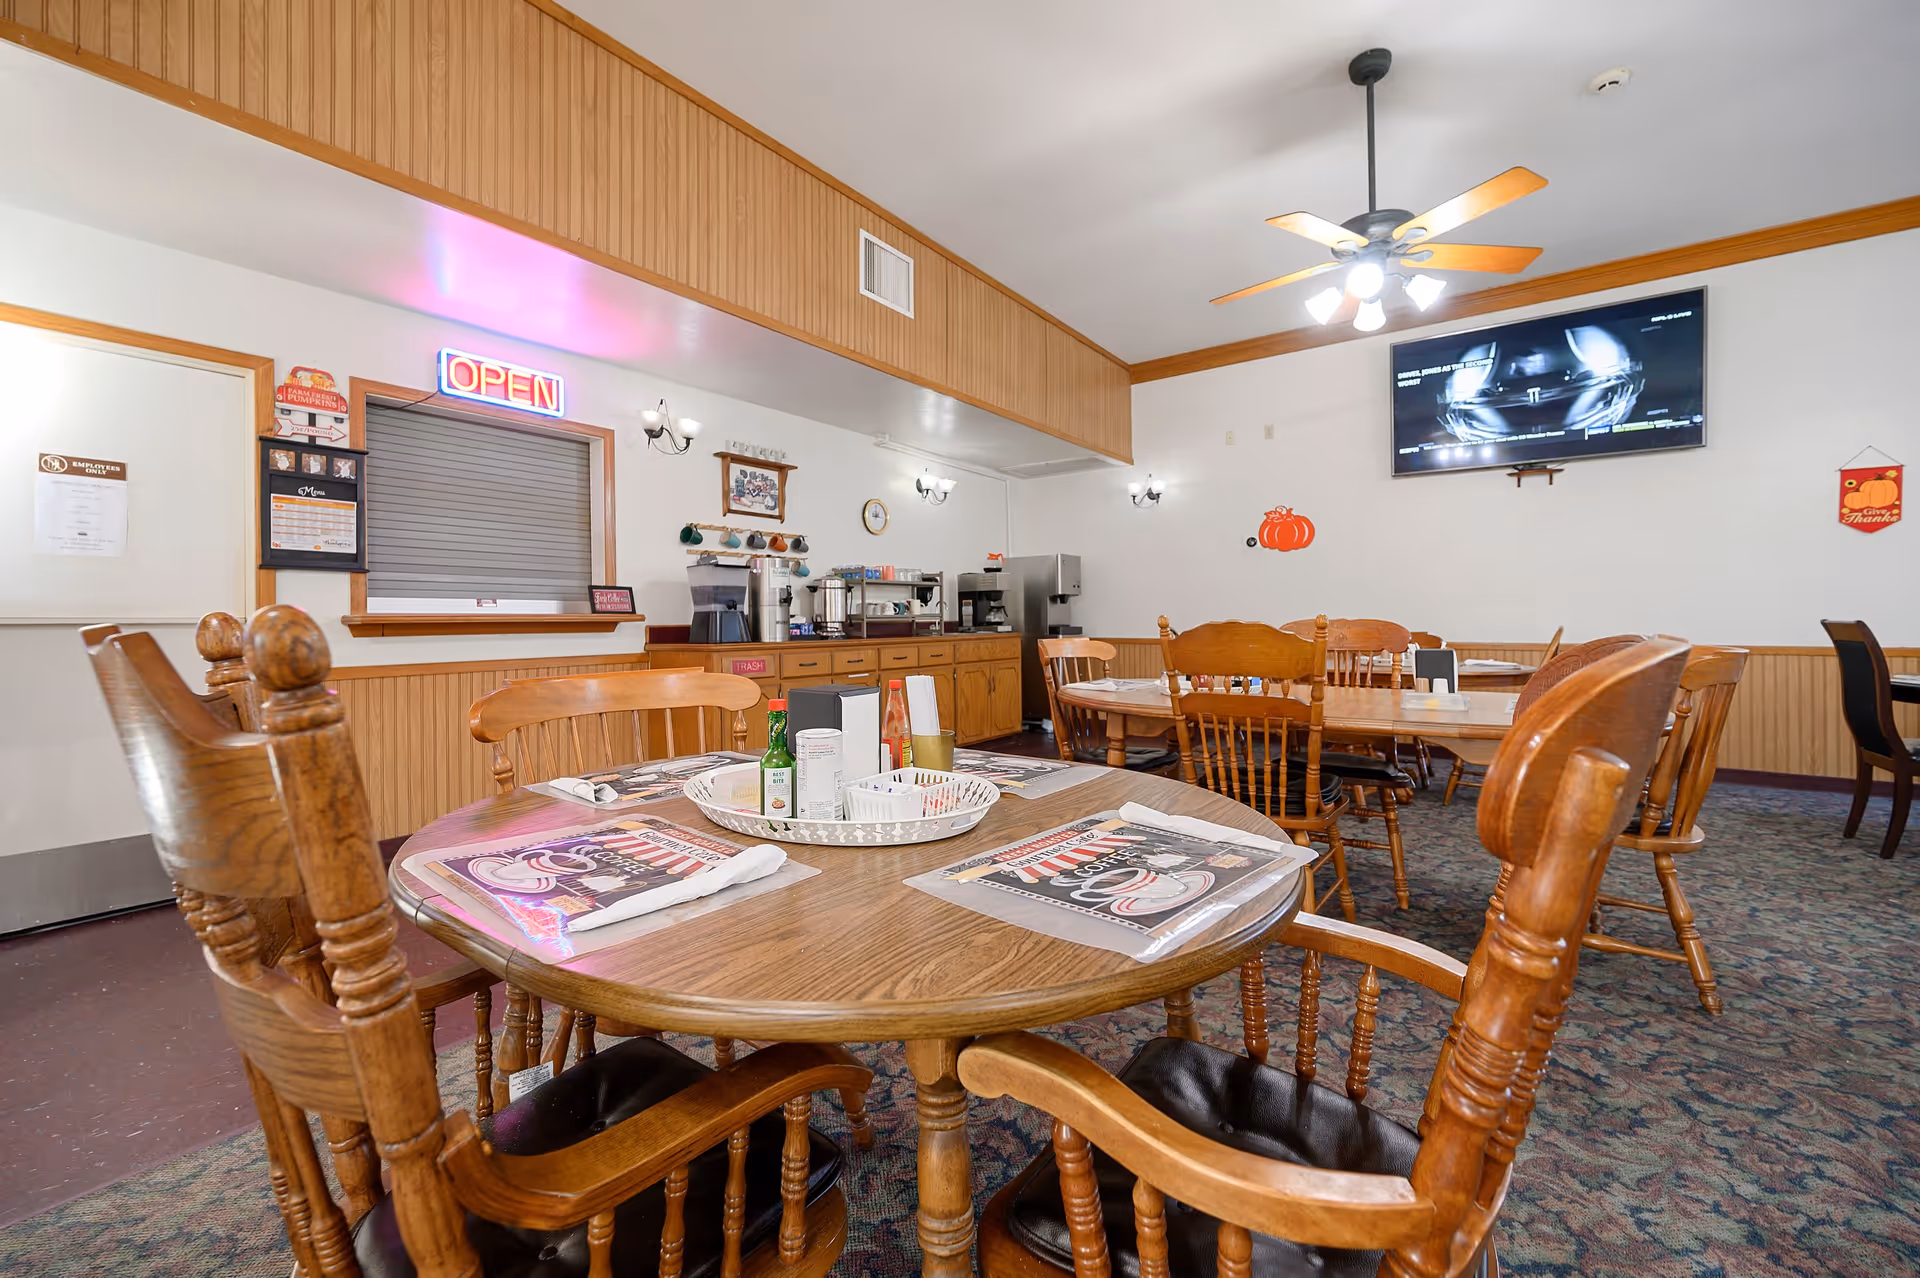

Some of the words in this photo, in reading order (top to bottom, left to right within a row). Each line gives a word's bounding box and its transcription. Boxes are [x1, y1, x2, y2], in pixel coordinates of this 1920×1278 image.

[1442, 364, 1452, 373] AS
[448, 355, 559, 411] OPEN
[1397, 378, 1422, 388] WORST
[287, 387, 311, 397] FARM
[311, 390, 337, 402] FRESH
[287, 393, 338, 409] PUMPKINS
[72, 461, 121, 472] EMPLOYEES
[298, 486, 326, 497] Menu
[1841, 511, 1900, 524] Thanks
[1863, 507, 1888, 515] Give
[737, 661, 763, 672] TRASH
[638, 831, 689, 855] Gourmet
[660, 827, 693, 842] FRESH
[692, 836, 737, 855] ROASTED
[994, 846, 1033, 863] FRESH
[1033, 830, 1079, 851] ROASTED
[594, 851, 654, 875] COFFEE
[1006, 843, 1072, 868] Gourmet
[1074, 846, 1137, 876] COFFEE
